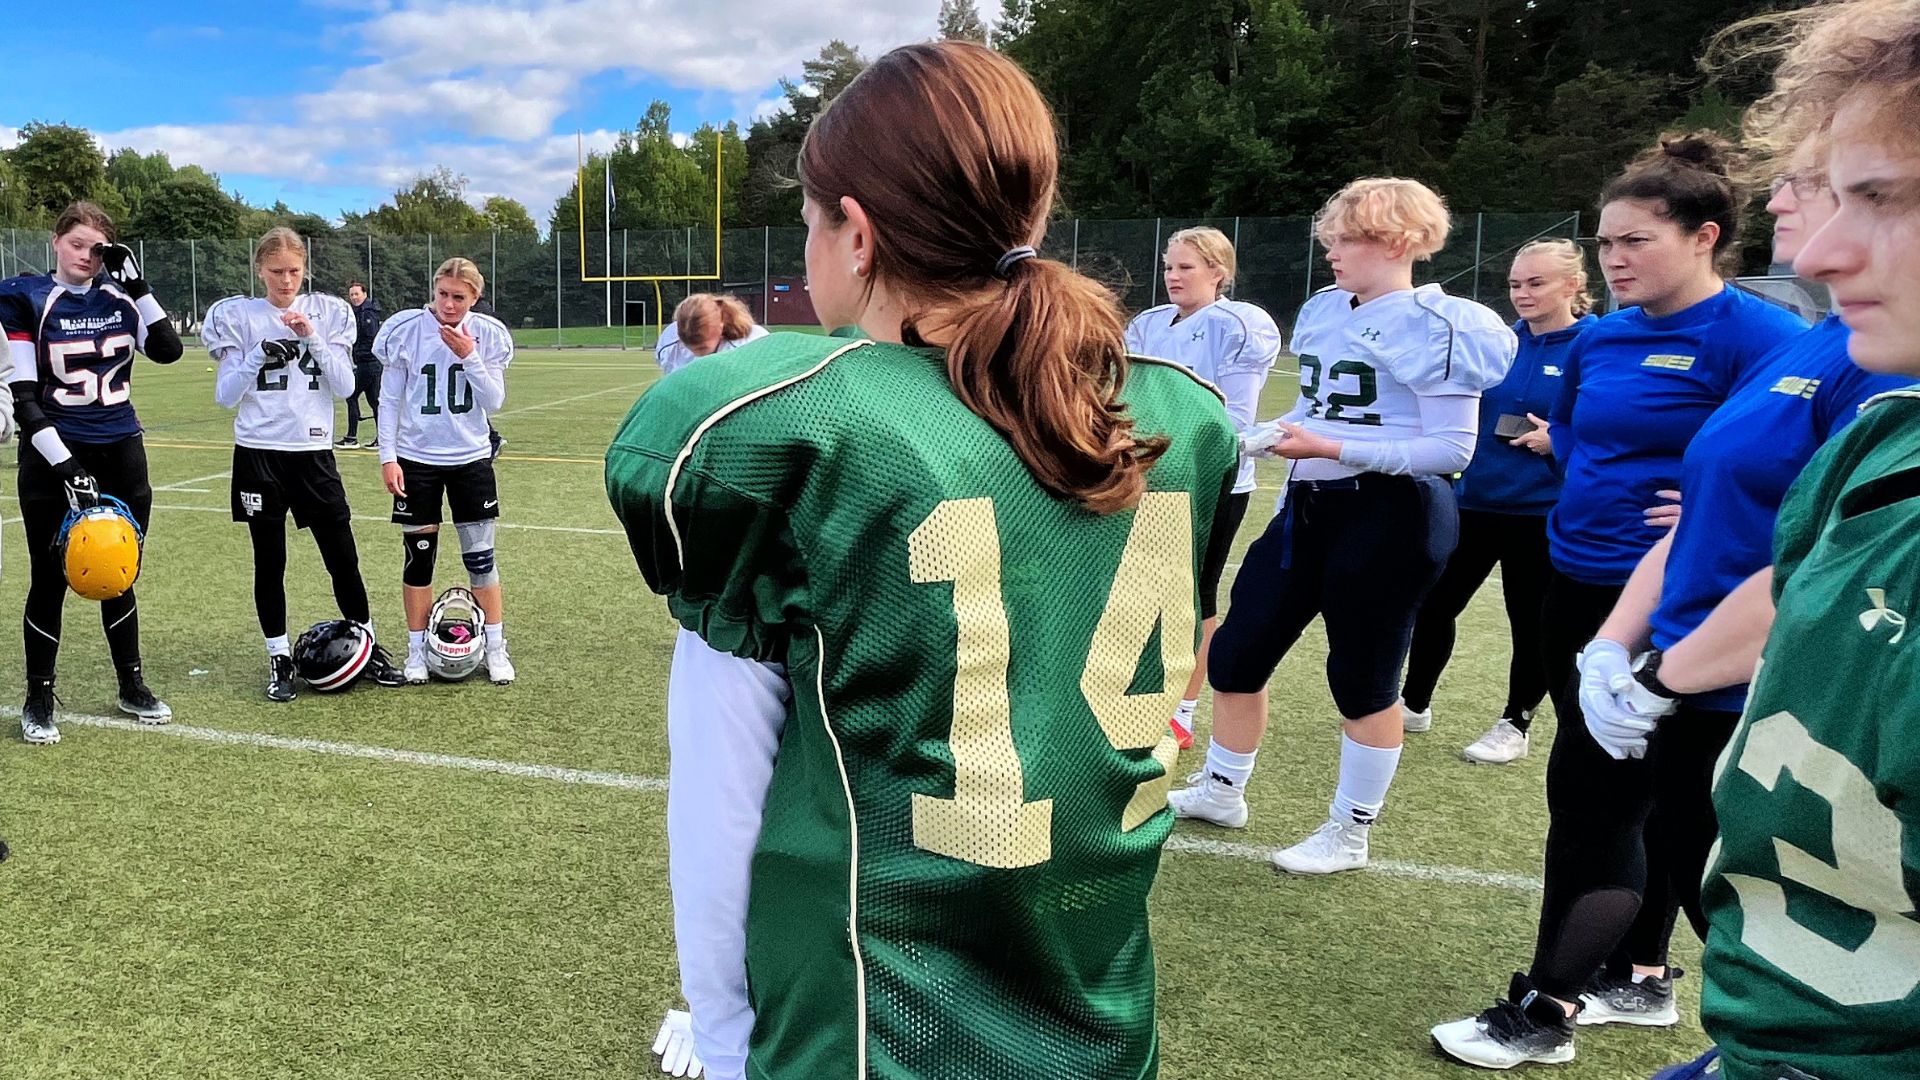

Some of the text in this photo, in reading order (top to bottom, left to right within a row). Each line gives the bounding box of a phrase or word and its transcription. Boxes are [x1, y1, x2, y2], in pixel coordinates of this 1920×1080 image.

[49, 334, 135, 405] 52
[257, 340, 322, 391] 24
[421, 363, 473, 414] 10
[437, 643, 471, 654] Riddell
[907, 491, 1196, 868] 14
